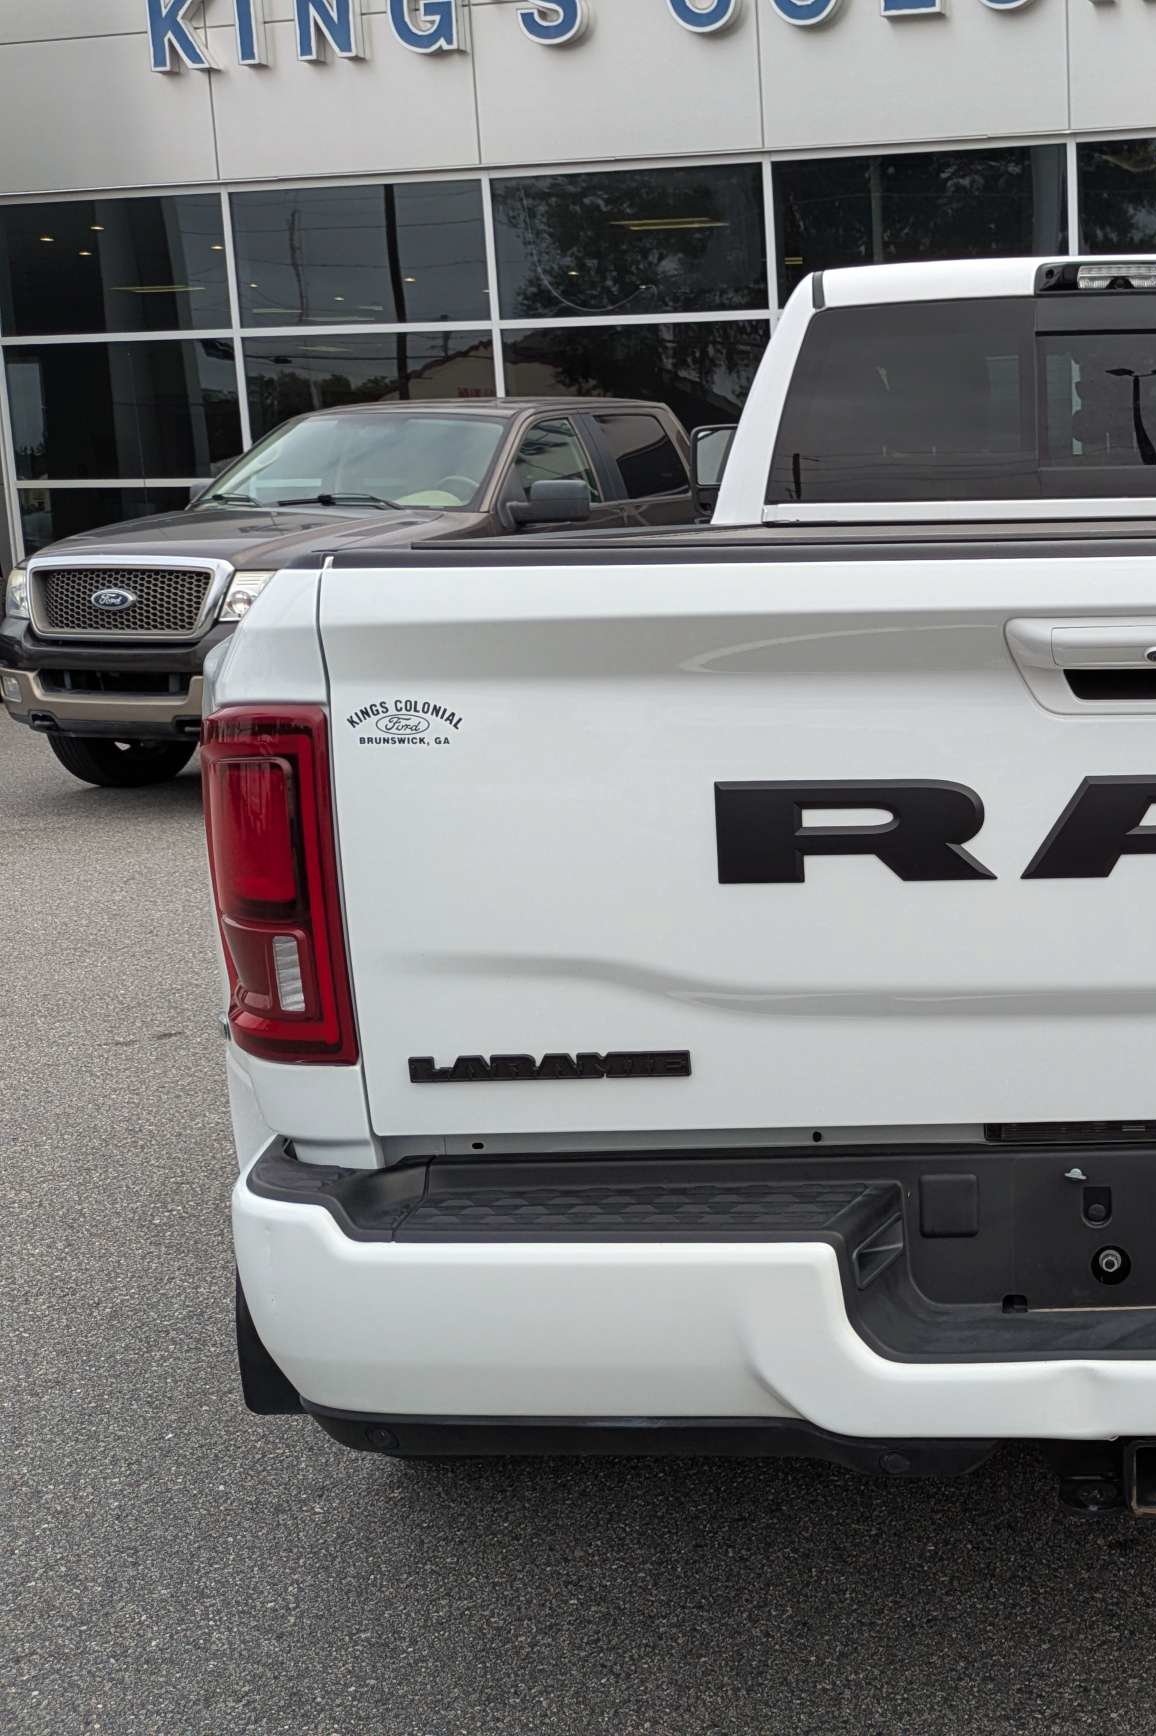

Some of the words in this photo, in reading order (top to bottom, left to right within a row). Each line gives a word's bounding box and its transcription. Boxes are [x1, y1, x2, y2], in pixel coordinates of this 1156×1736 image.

[99, 593, 122, 605] Ford
[346, 701, 389, 729] KINGS
[394, 699, 463, 730] COLONIAL
[384, 716, 422, 732] Ford
[359, 736, 430, 746] BRUNSWICK,
[434, 736, 451, 745] GA
[408, 1050, 692, 1083] LARAMIE
